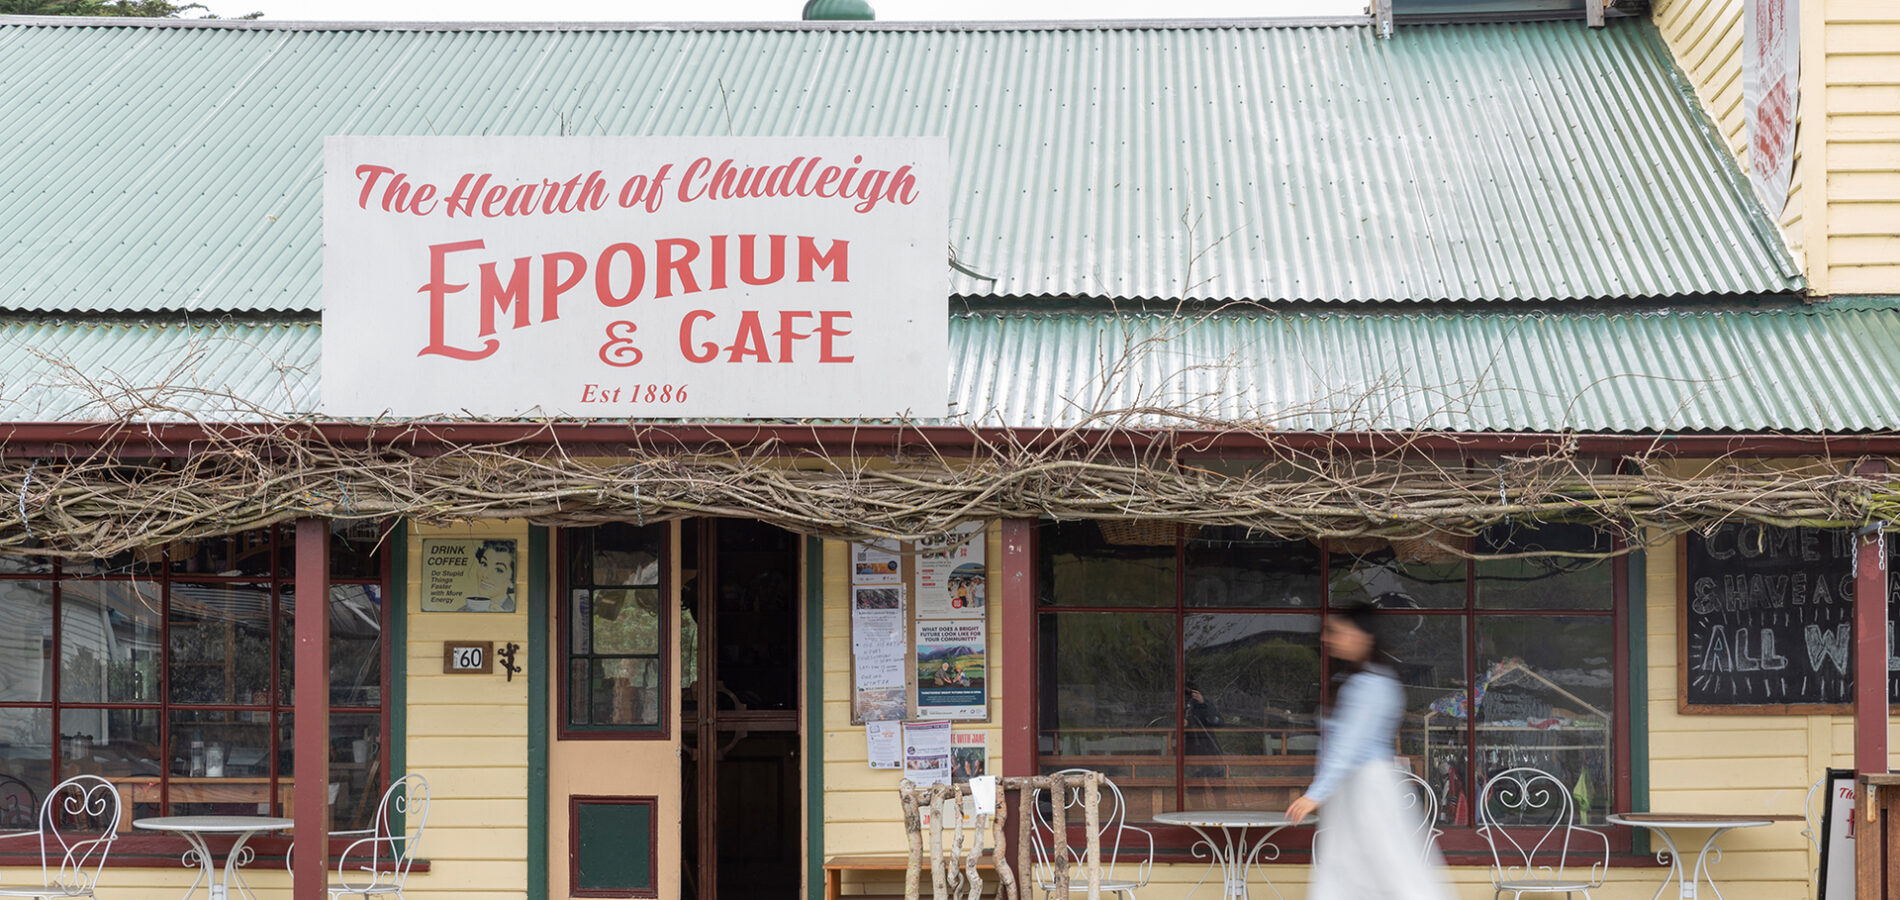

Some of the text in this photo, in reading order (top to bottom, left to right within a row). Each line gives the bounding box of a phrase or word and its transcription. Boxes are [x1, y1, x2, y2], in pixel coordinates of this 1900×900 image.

[354, 154, 920, 219] The Hearth of Chudleigh
[598, 309, 855, 368] & CAFE
[580, 383, 689, 404] Est 1886
[431, 545, 466, 555] DRINK
[1705, 525, 1821, 561] COME
[427, 557, 468, 566] COFFEE
[1692, 577, 1723, 614] &
[1724, 573, 1806, 612] HAVE
[1812, 574, 1833, 604] A
[460, 648, 482, 668] 60
[1702, 624, 1788, 672] ALL
[957, 733, 971, 744] WITH
[971, 733, 985, 744] JANE
